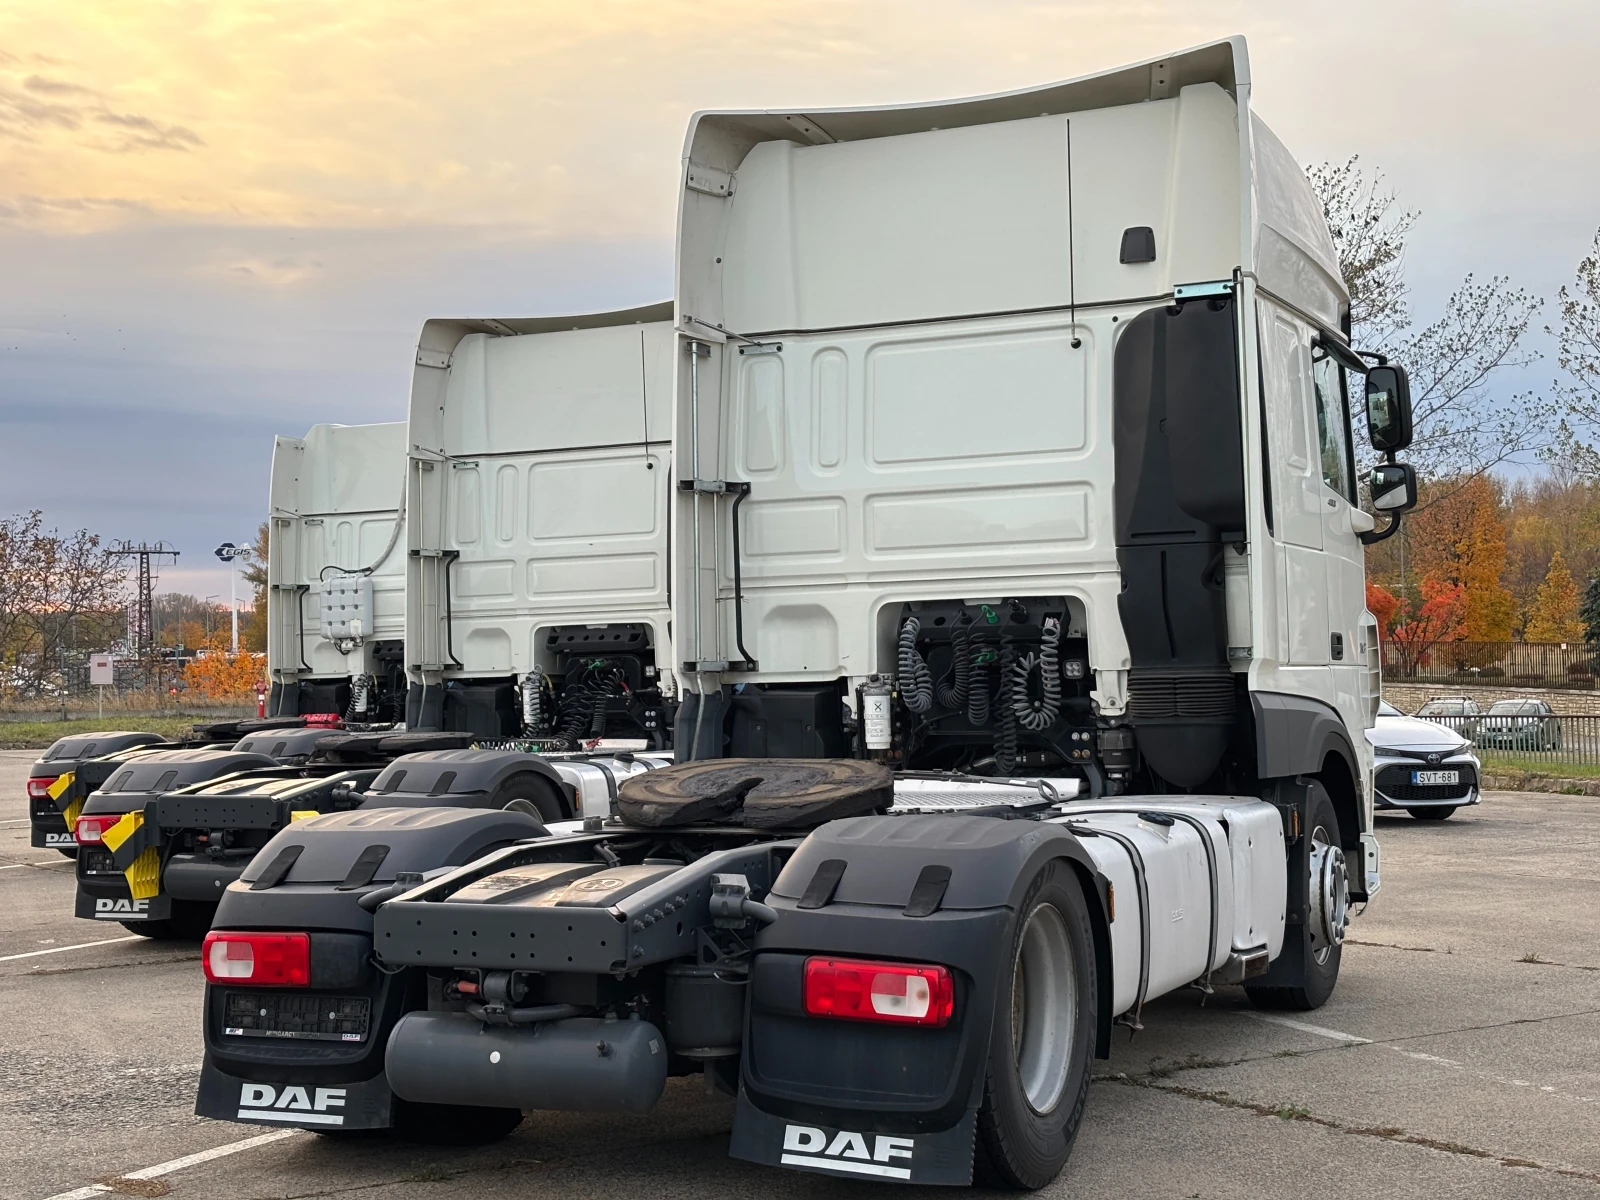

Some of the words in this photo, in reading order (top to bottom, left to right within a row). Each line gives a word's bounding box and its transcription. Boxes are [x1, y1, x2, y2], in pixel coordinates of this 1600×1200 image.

[225, 548, 251, 556] EGIS
[1419, 772, 1457, 783] SVT-681
[45, 833, 77, 842] DA
[95, 898, 149, 912] DAF
[240, 1083, 346, 1111] DAF
[782, 1124, 914, 1162] DAF
